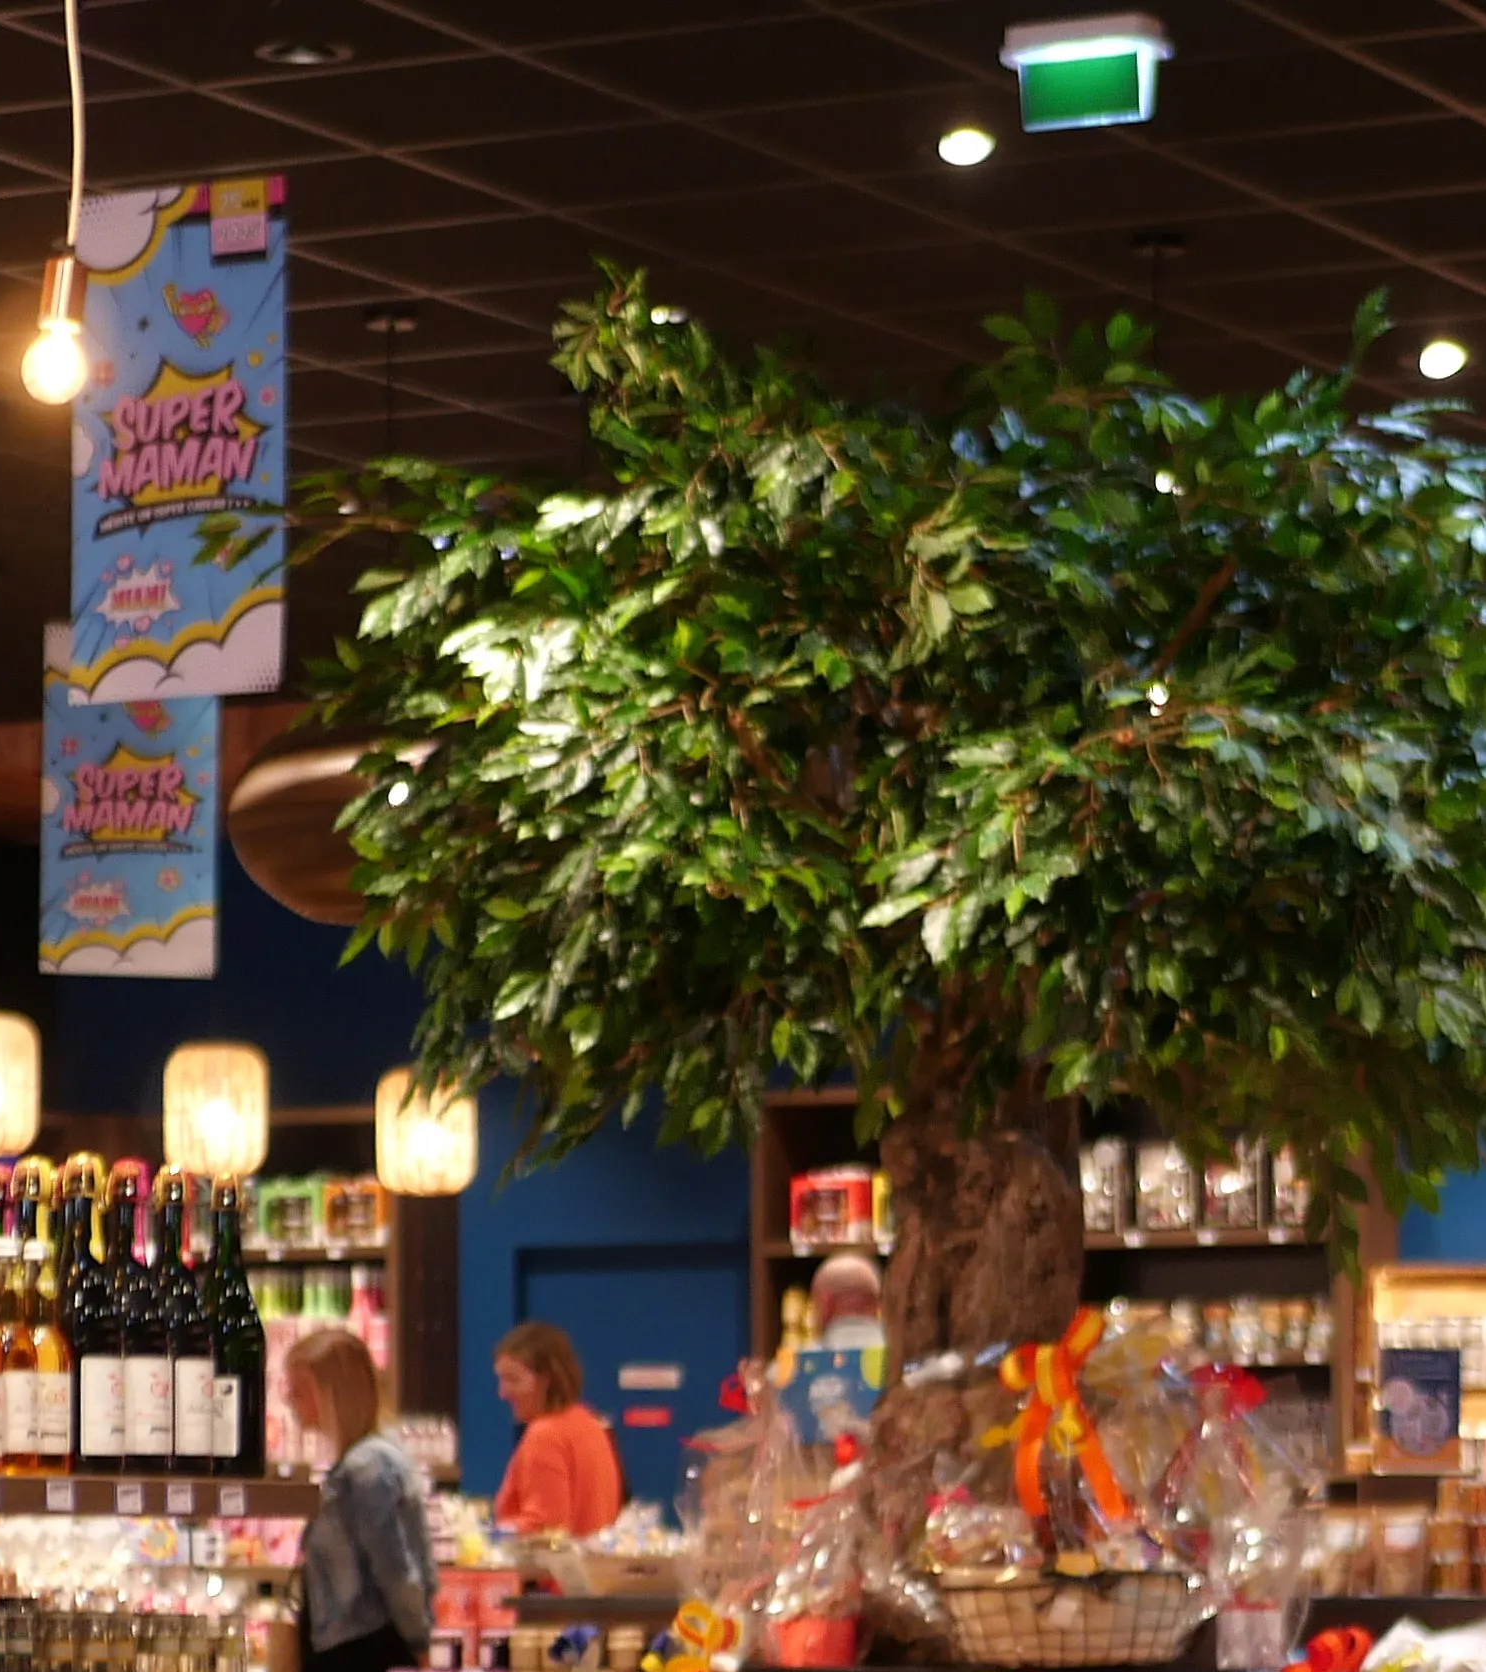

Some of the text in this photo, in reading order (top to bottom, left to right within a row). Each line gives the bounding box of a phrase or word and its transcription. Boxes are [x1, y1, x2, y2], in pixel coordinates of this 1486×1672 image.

[113, 378, 246, 453] SUPER
[98, 436, 260, 501] MAMAN
[77, 761, 186, 803] SUPER
[64, 800, 195, 837] MAMAN
